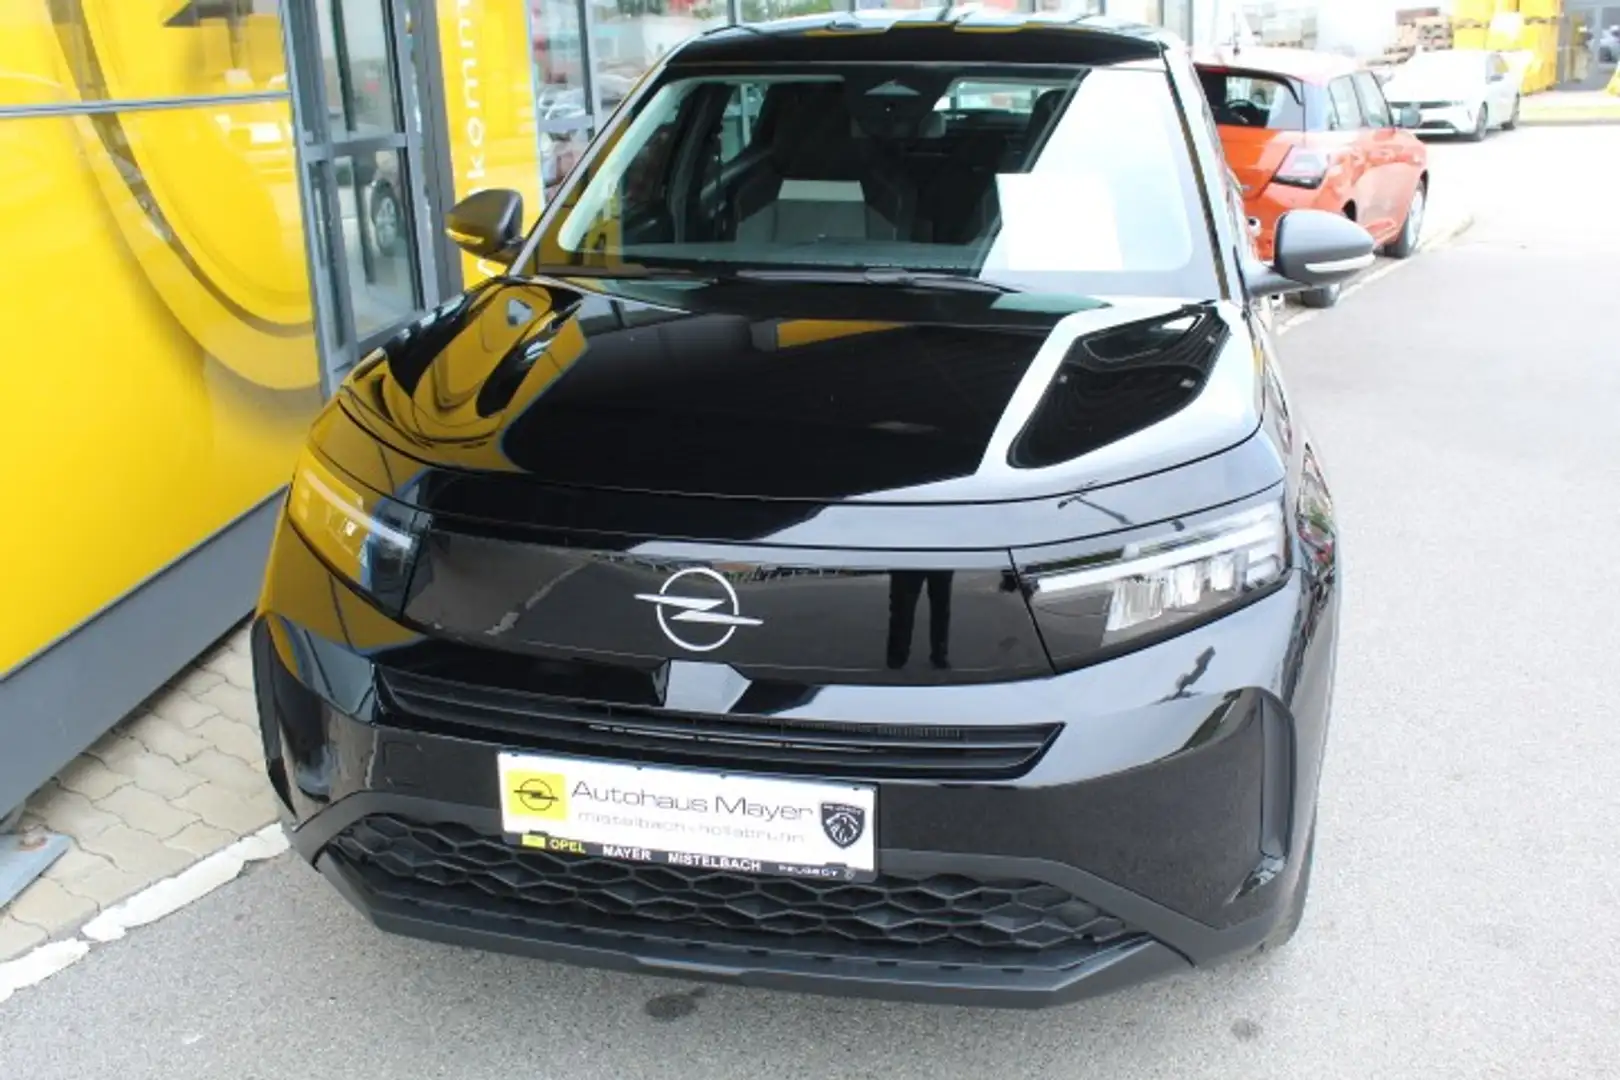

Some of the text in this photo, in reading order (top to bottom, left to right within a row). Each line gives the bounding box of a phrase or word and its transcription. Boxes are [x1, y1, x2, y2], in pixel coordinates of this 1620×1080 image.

[571, 780, 814, 822] Autohaus Mayer
[548, 837, 587, 854] OPEL
[602, 843, 652, 861] MAYER
[667, 851, 762, 872] MISTELBACH
